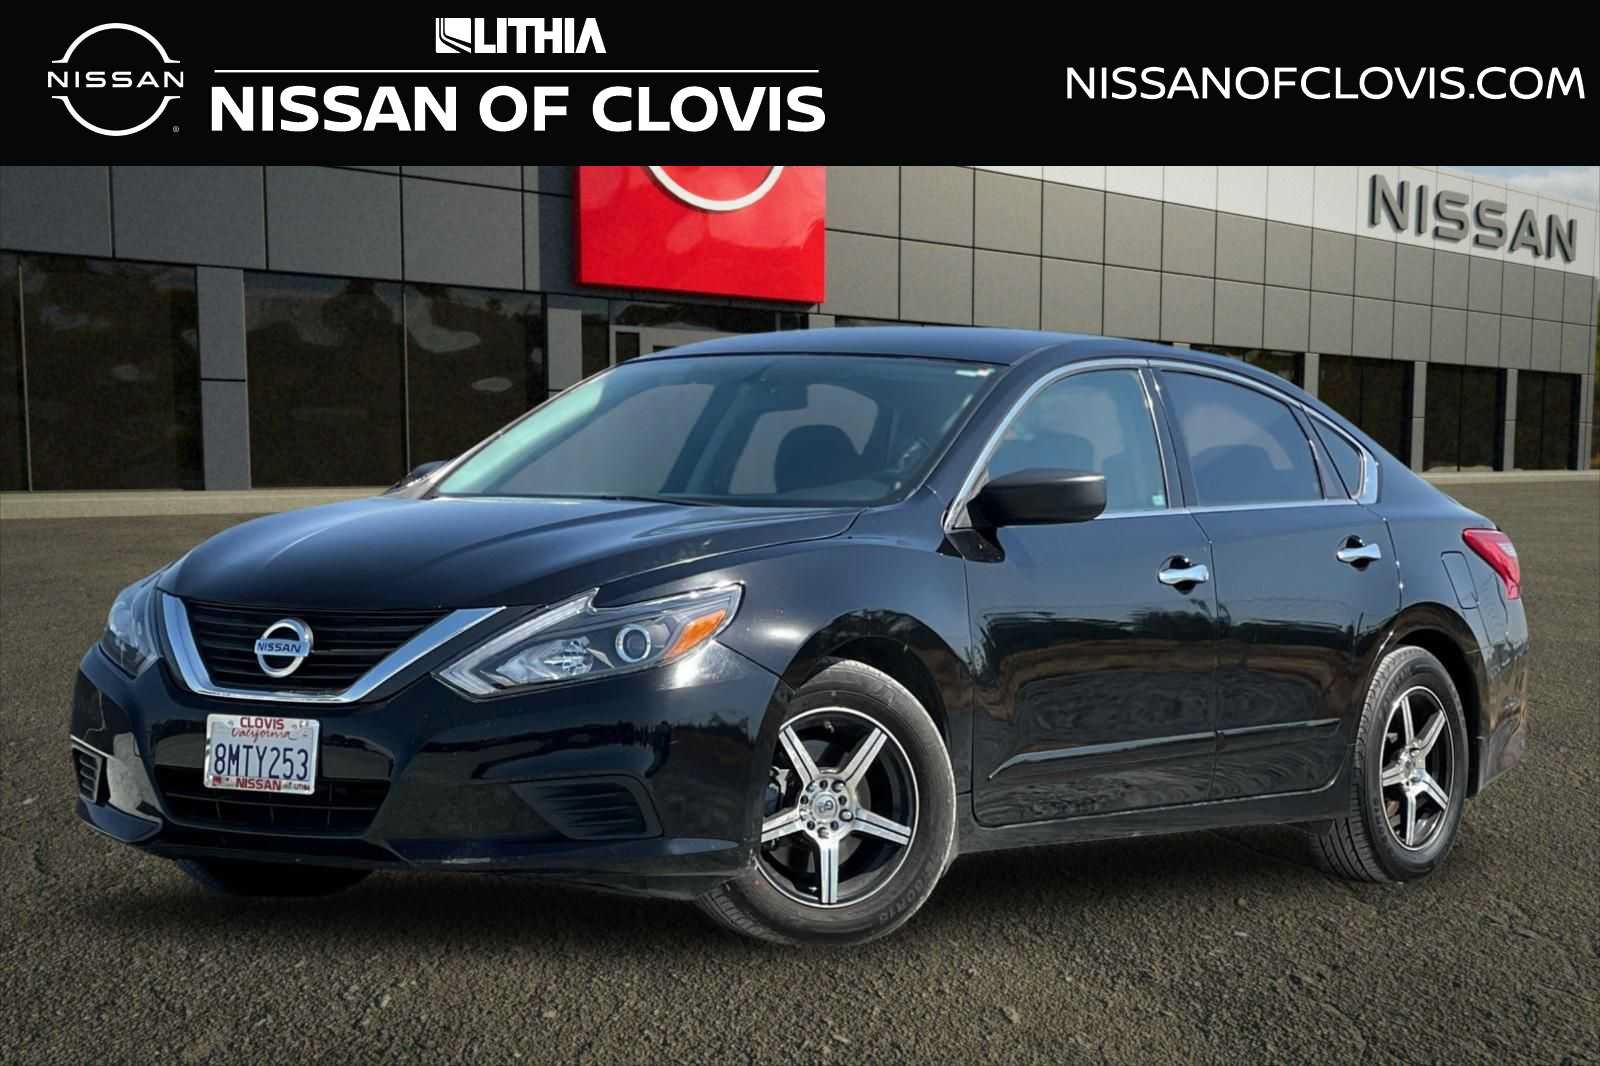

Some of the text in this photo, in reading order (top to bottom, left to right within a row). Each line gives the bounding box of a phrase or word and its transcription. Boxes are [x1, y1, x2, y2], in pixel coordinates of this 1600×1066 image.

[1368, 174, 1578, 263] NISSAN
[257, 641, 302, 653] NISSAN
[240, 716, 285, 730] CLOVIS
[231, 727, 291, 743] California
[214, 743, 309, 781] 8MTY253
[235, 776, 282, 791] NISSAN
